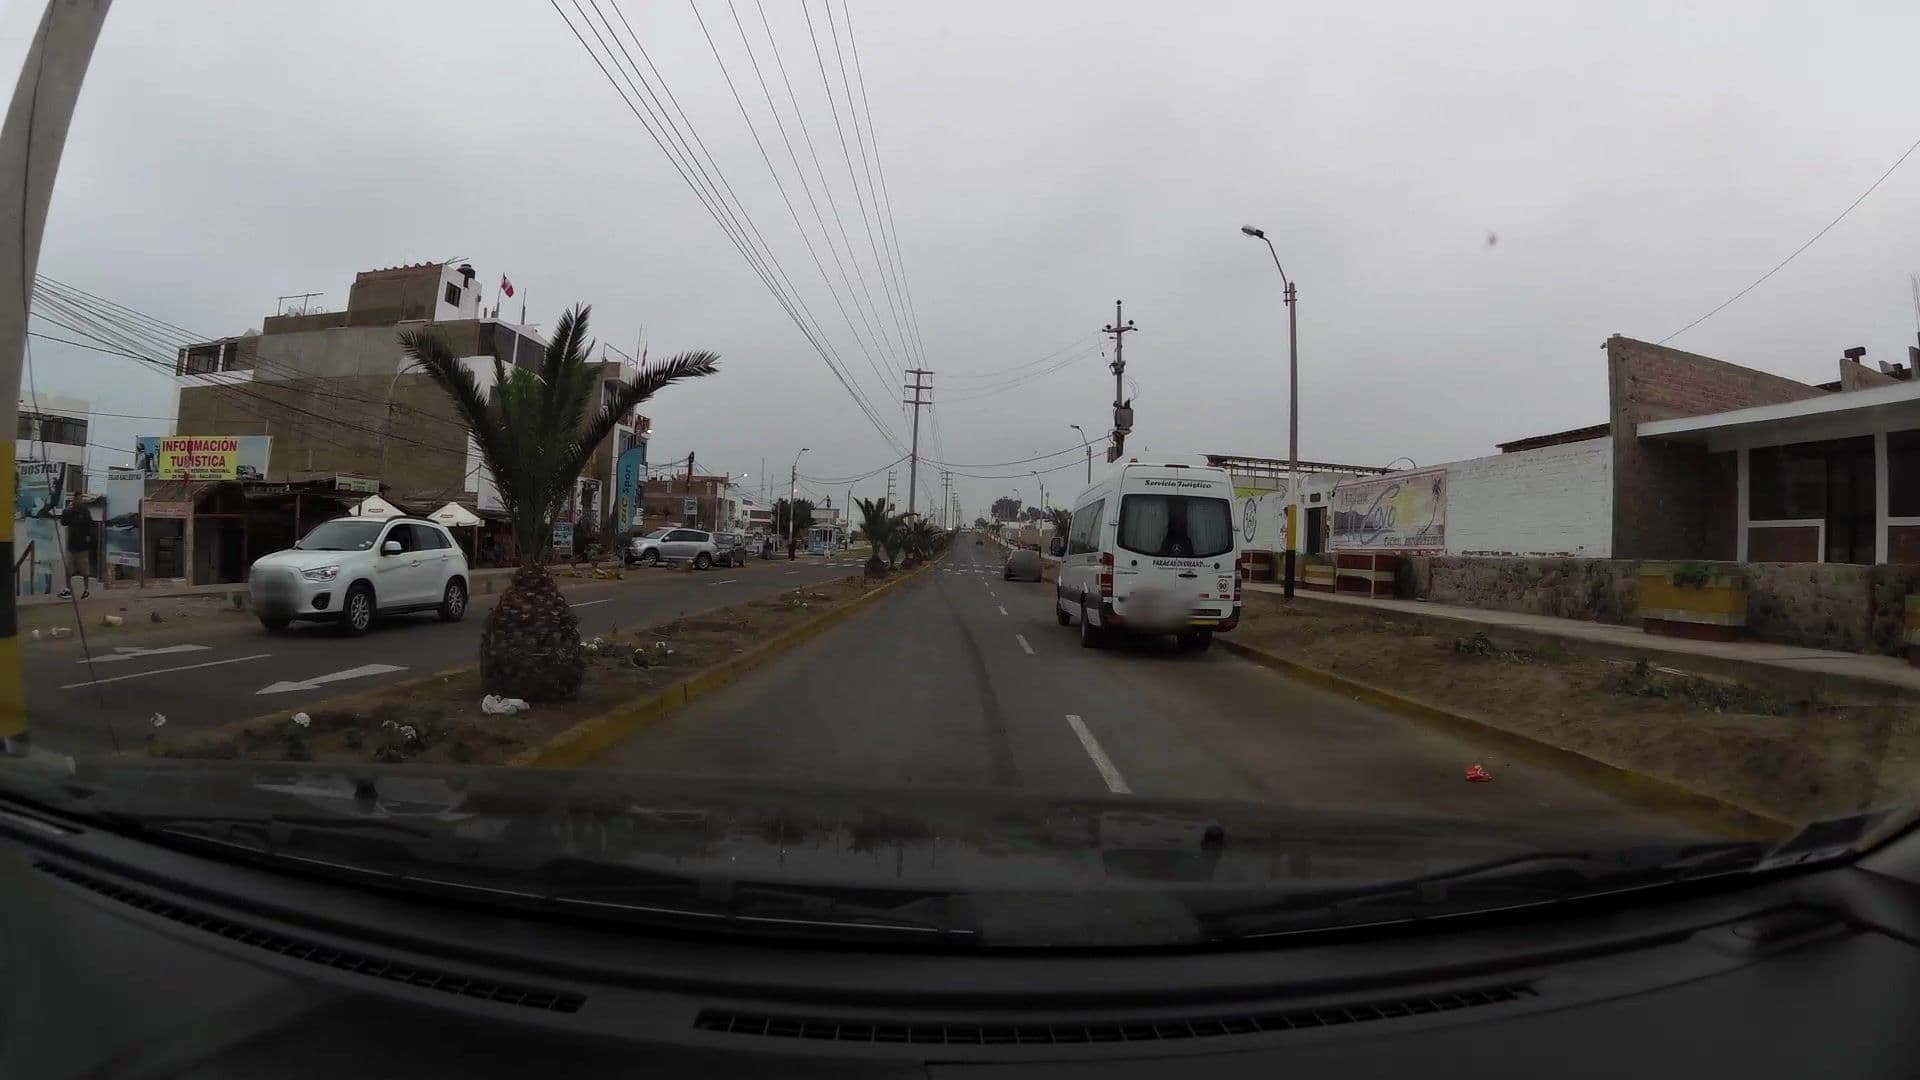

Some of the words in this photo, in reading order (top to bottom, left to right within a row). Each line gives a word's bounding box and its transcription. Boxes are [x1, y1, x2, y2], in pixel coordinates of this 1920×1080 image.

[1144, 480, 1176, 488] Servicio
[1152, 559, 1177, 567] PARACAS
[1218, 582, 1227, 590] 90
